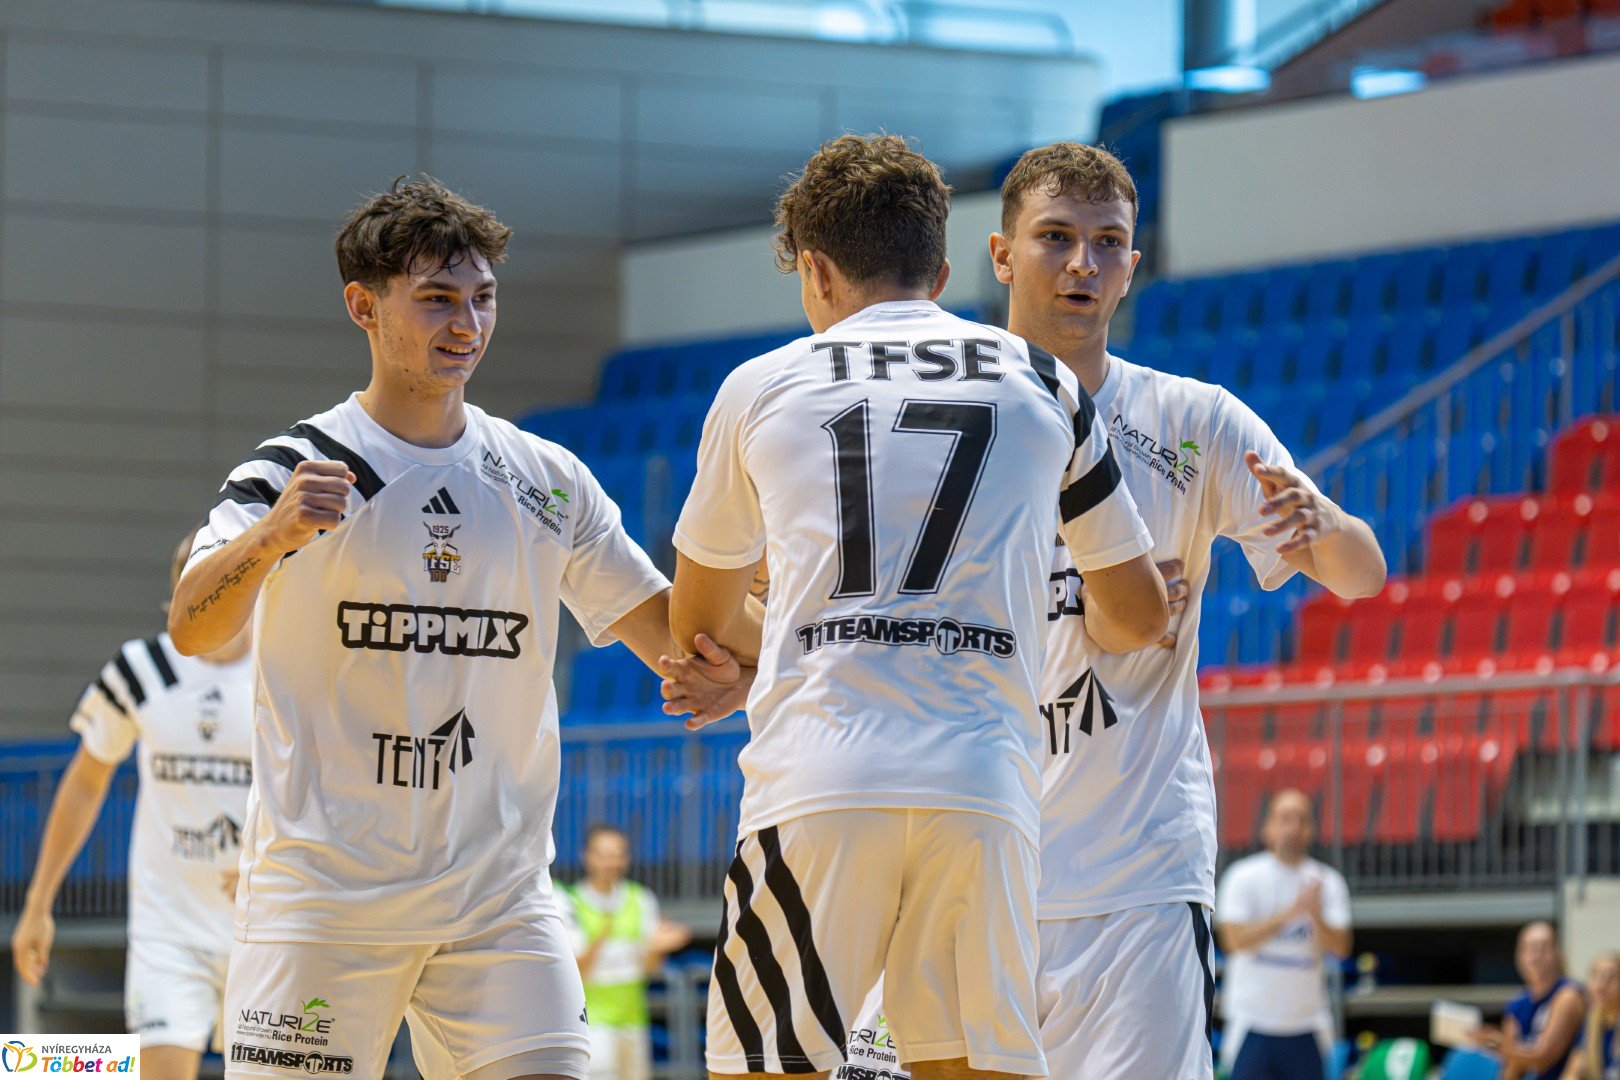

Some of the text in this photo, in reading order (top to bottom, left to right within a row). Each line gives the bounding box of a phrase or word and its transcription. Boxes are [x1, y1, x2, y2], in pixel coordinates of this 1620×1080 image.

[811, 339, 1006, 383] TFSE
[1149, 458, 1166, 476] Rice
[518, 495, 562, 535] Rice Protein
[820, 398, 997, 599] 17
[795, 615, 1016, 658] 11TEAMSPORTS
[372, 733, 447, 790] TENT
[239, 1000, 335, 1034] NATURIZE
[271, 1030, 292, 1042] Rice
[294, 1033, 328, 1047] Protein
[866, 1047, 897, 1063] Protein
[230, 1042, 354, 1075] 11TEAMSPORTS
